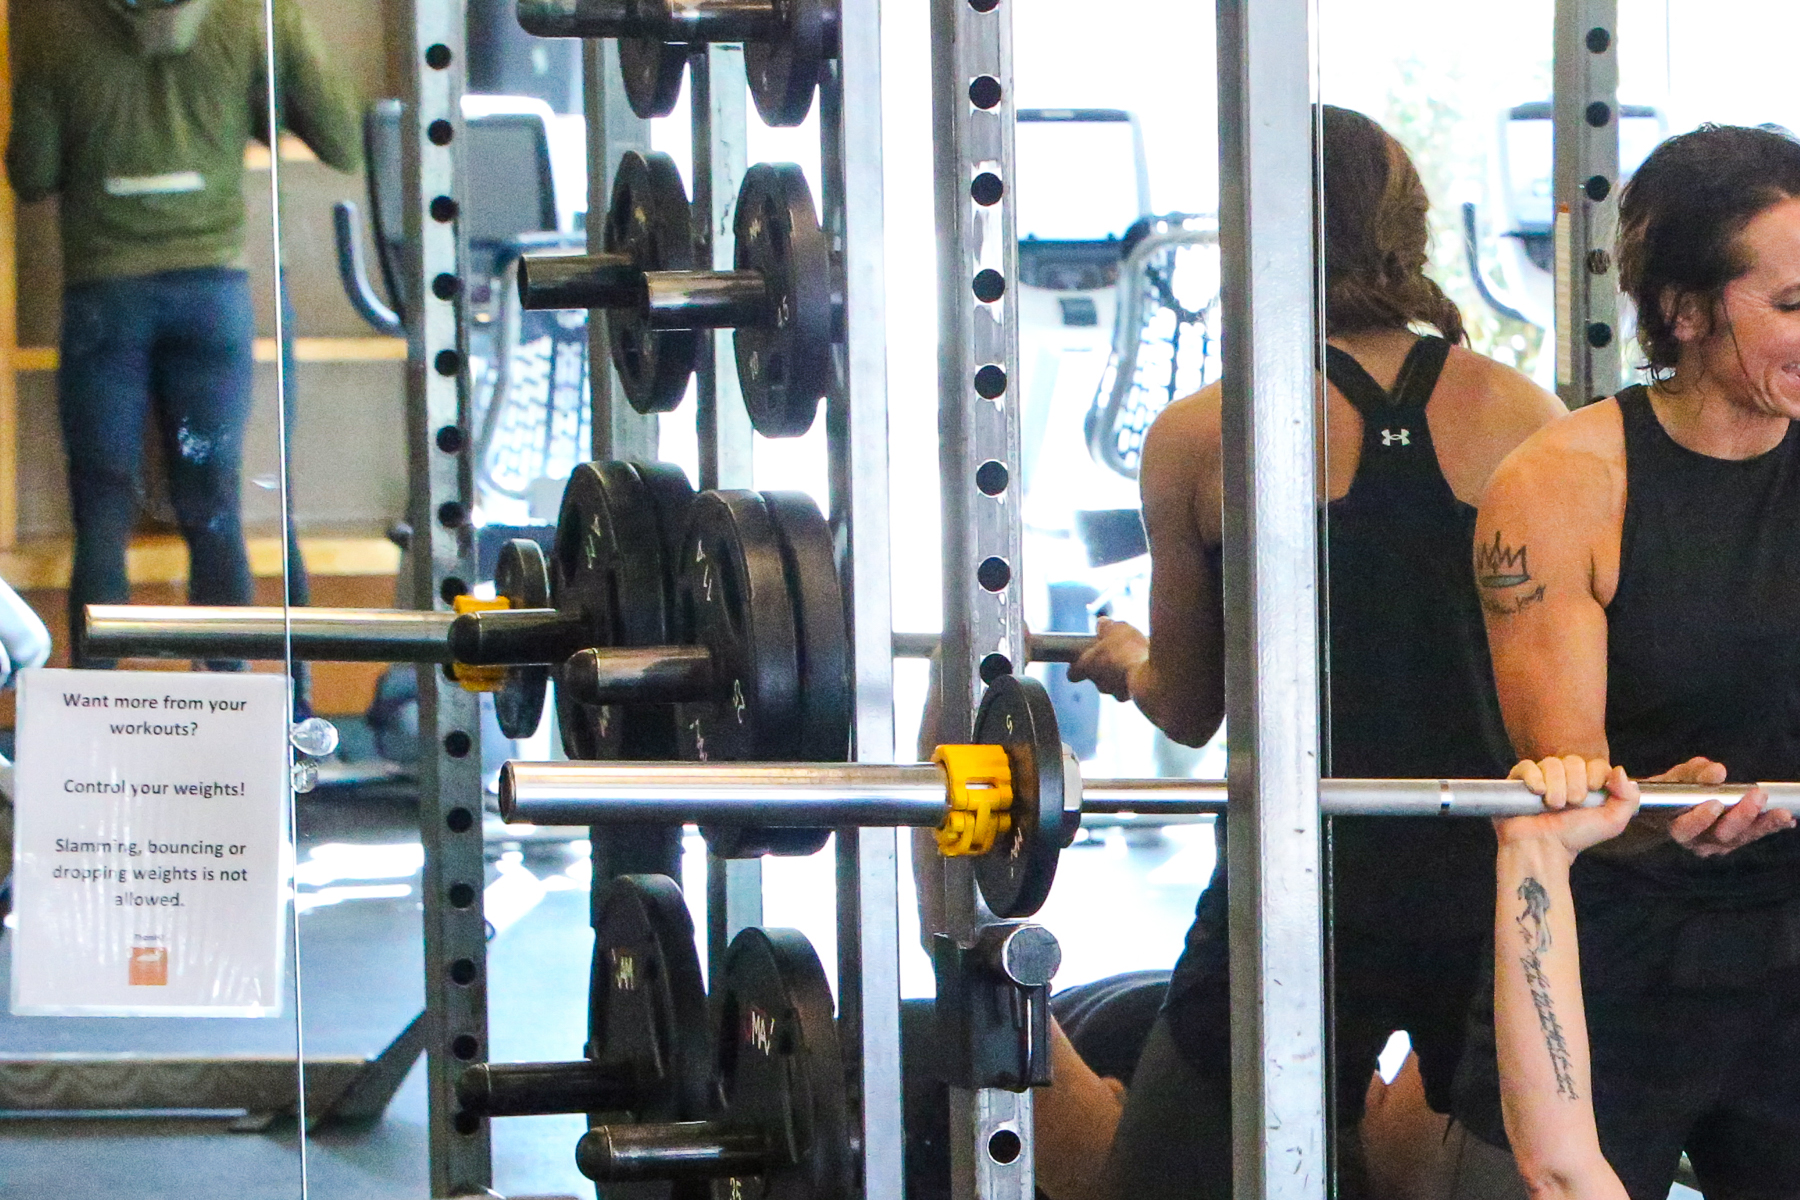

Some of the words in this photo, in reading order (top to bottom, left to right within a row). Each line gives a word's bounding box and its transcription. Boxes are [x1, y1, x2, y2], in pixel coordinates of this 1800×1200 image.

[63, 692, 110, 709] Want
[114, 696, 158, 710] more
[164, 695, 203, 710] from
[209, 698, 248, 714] your
[110, 721, 198, 737] workouts?
[64, 778, 126, 795] Control
[131, 782, 169, 798] your
[174, 782, 246, 798] weights!
[148, 840, 224, 858] bouncing
[229, 844, 247, 856] or
[133, 867, 197, 884] weights
[203, 867, 215, 882] is
[220, 869, 248, 883] not
[115, 892, 186, 907] allowed.
